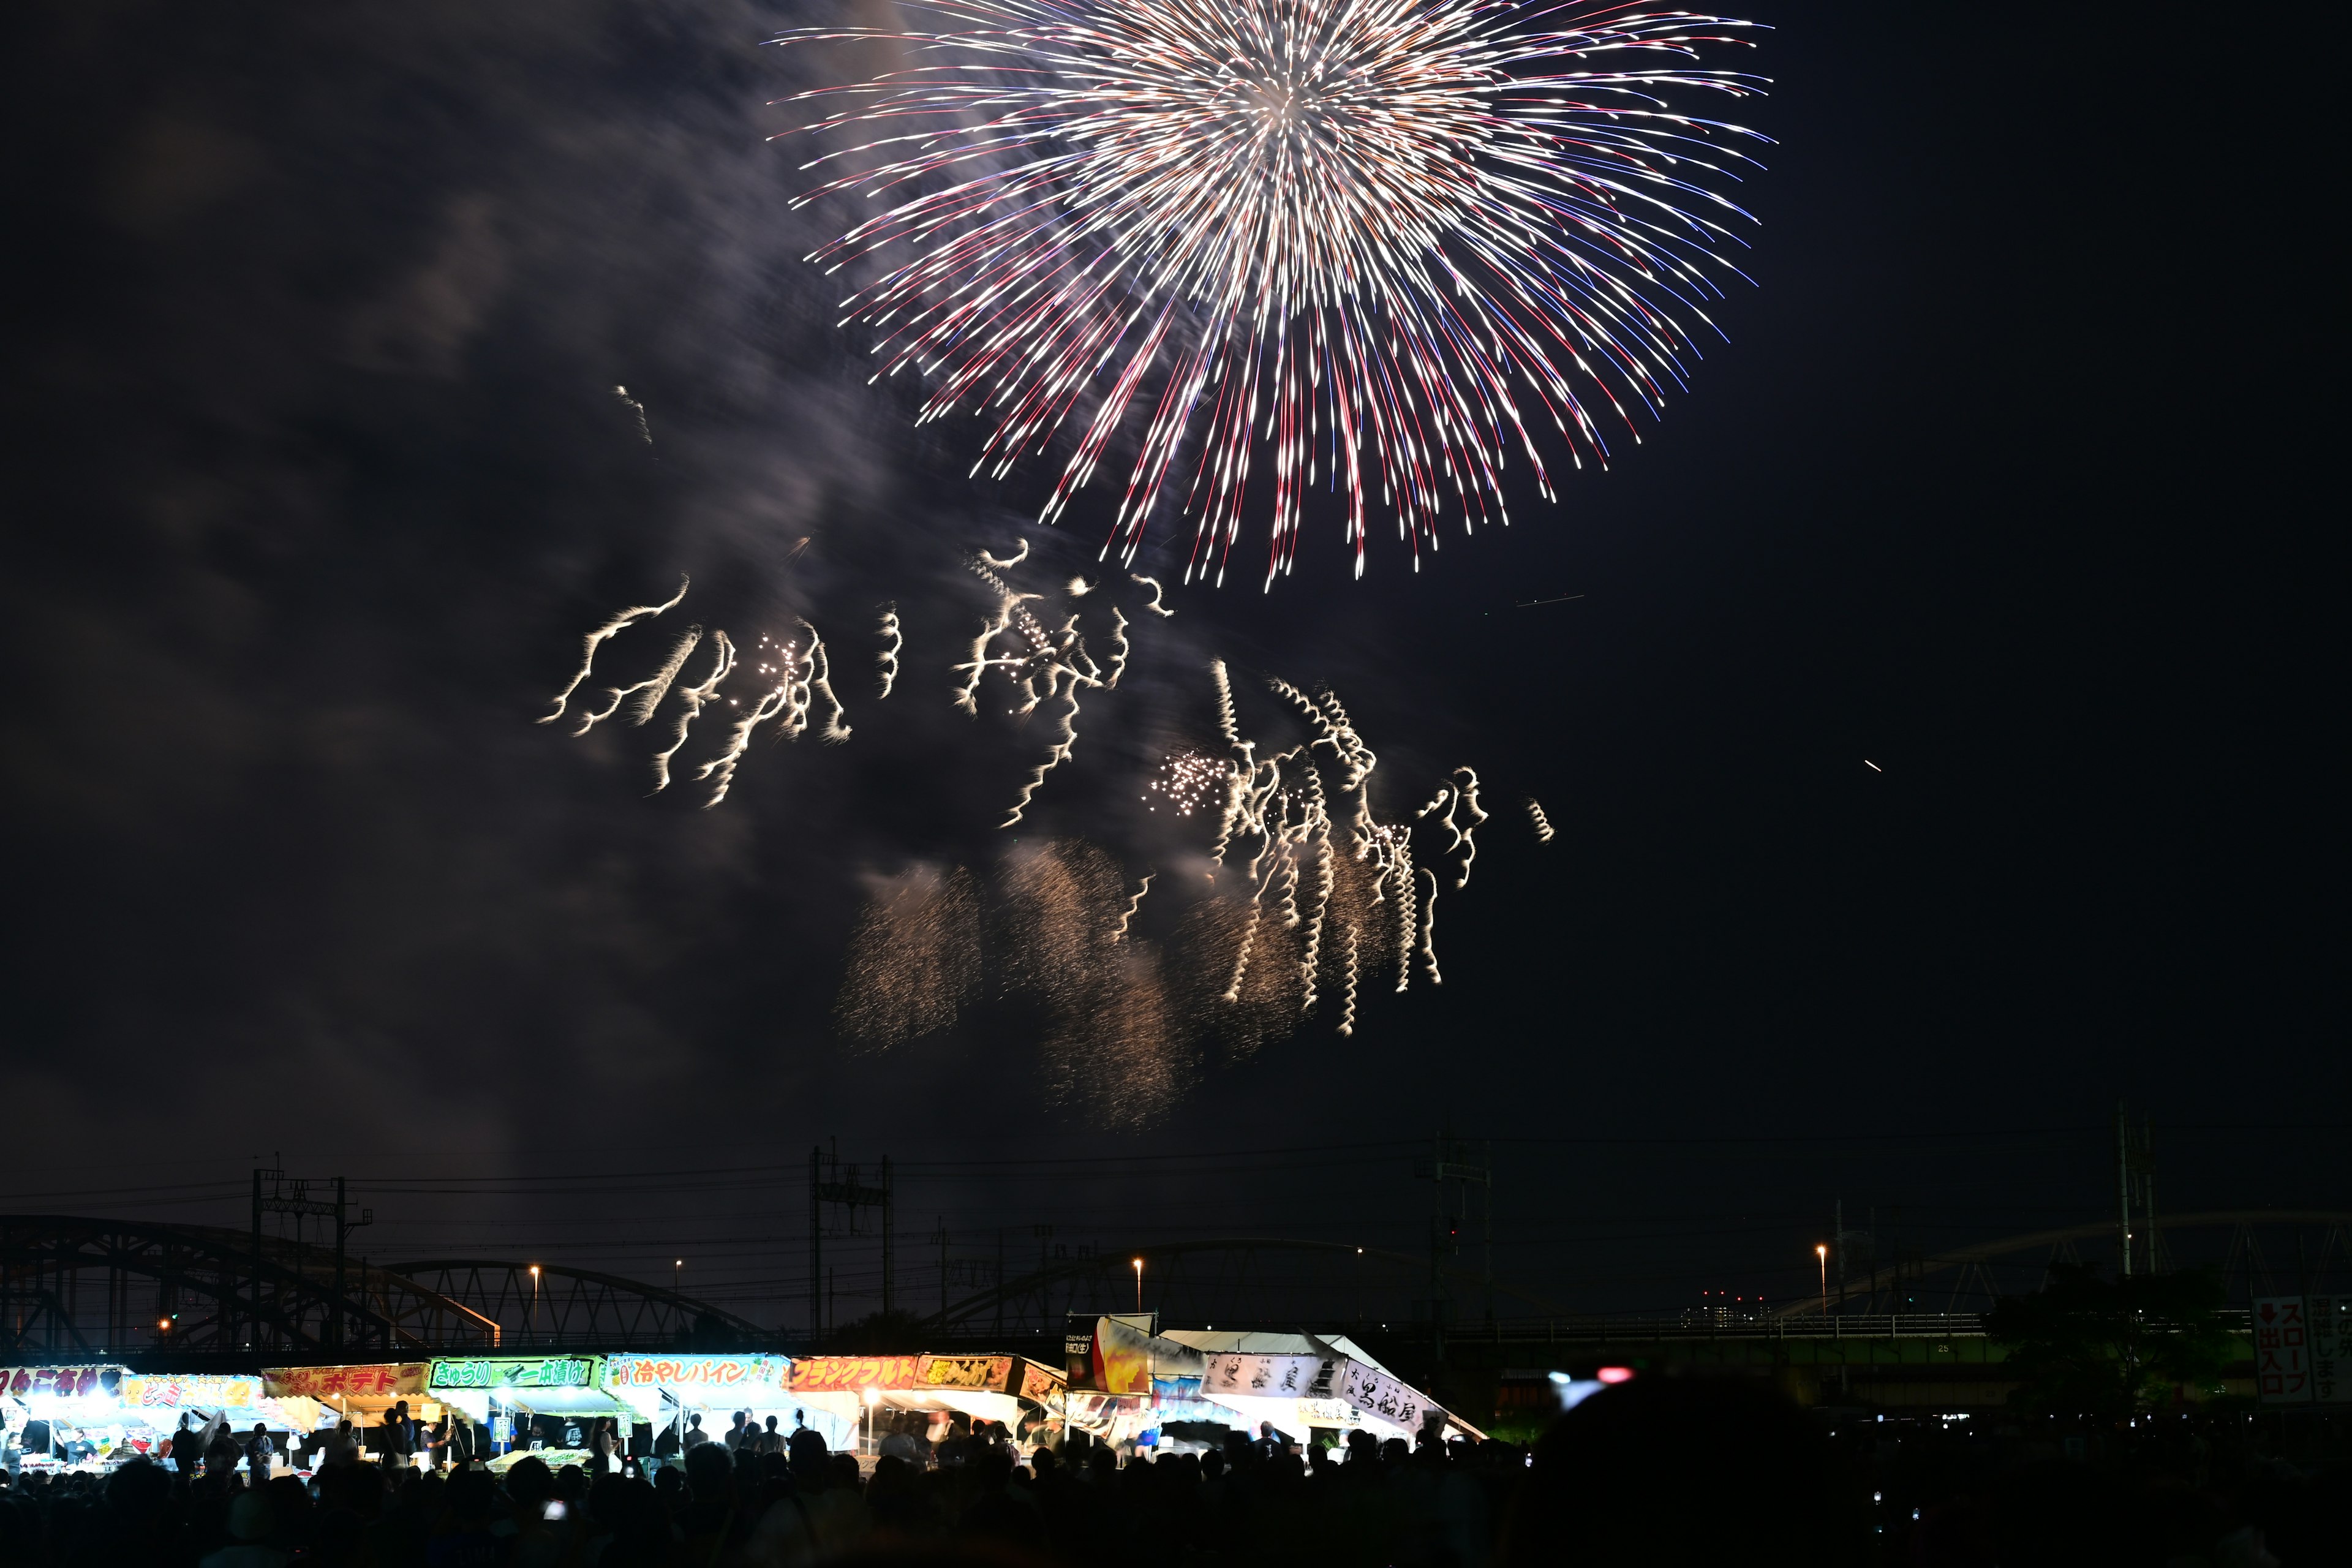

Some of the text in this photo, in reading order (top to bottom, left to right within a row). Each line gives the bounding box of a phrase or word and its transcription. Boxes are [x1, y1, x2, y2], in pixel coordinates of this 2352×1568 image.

[2258, 1327, 2283, 1395] 出入口
[2282, 1303, 2307, 1393] スロープ
[2312, 1298, 2336, 1399] 混雑します
[318, 1368, 398, 1395] ポテト
[435, 1362, 491, 1387] きゅうり
[518, 1359, 586, 1387] 一本漬け
[634, 1360, 745, 1384] 冷やしパイン
[792, 1359, 914, 1386] フランクフルト
[1358, 1379, 1415, 1426] 黒船屋
